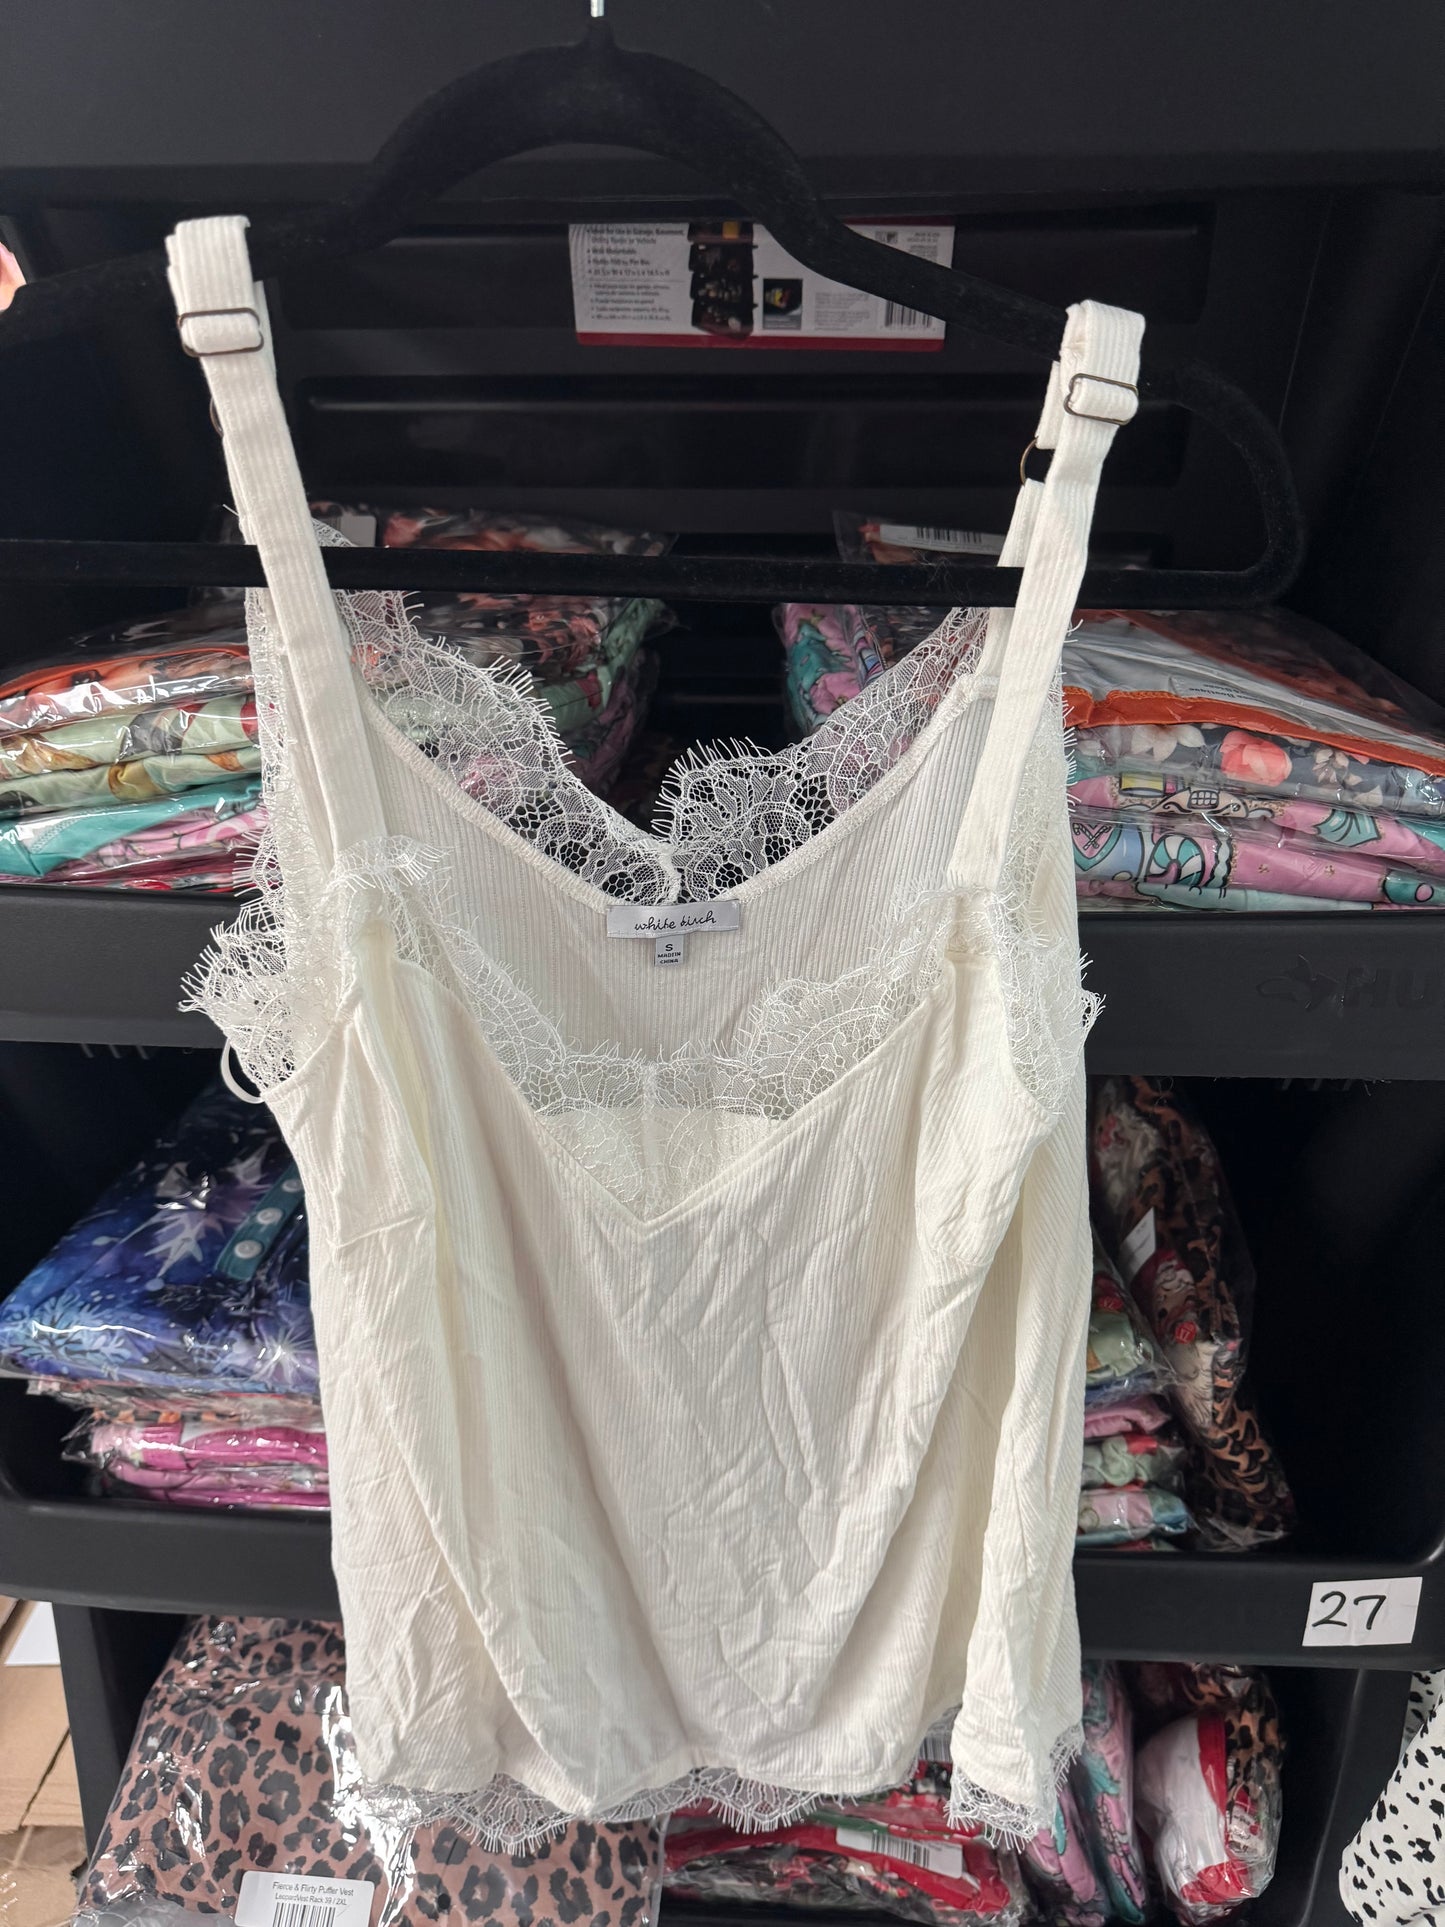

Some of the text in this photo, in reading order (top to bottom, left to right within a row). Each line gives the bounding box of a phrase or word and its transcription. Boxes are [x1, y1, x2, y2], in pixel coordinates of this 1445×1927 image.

[634, 910, 717, 931] white birch
[665, 943, 674, 952] S
[1311, 1590, 1387, 1631] 27
[272, 1881, 293, 1891] Fierce
[294, 1883, 300, 1891] &
[301, 1883, 317, 1894] Flirty
[339, 1887, 354, 1897] Vest
